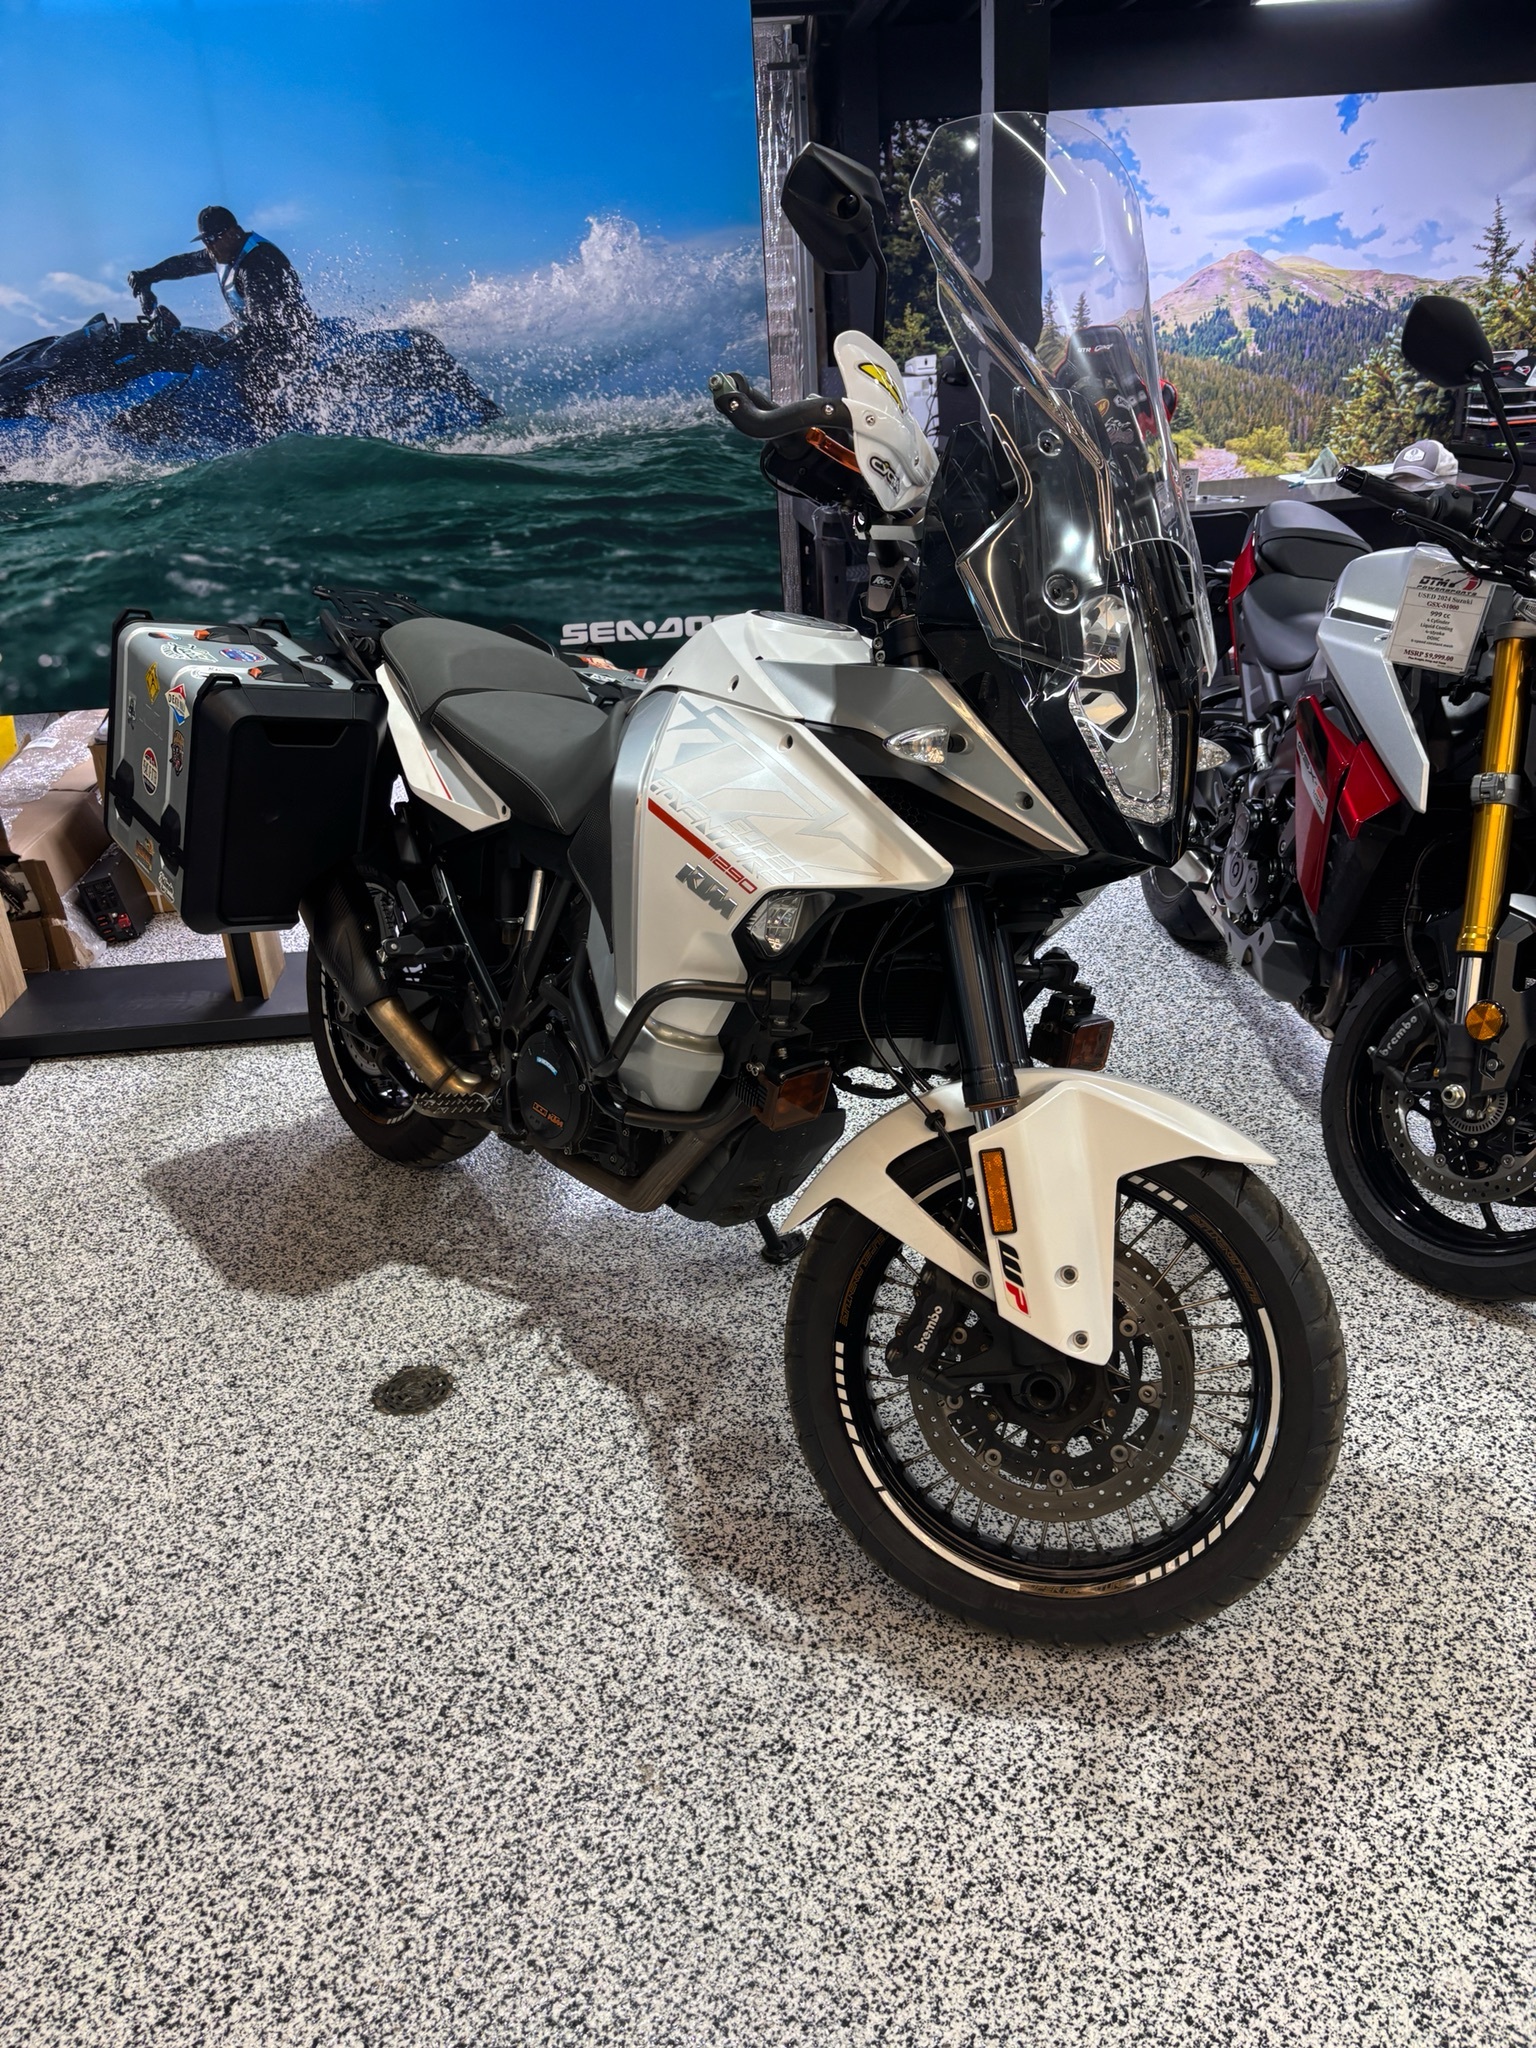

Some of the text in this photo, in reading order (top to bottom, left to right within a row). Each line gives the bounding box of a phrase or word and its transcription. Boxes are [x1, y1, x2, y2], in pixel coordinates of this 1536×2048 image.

[1419, 576, 1450, 587] DTM
[1418, 592, 1474, 605] USED 2024 Suzuki
[1430, 610, 1443, 618] 999
[1403, 649, 1424, 658] MSRP
[710, 853, 758, 895] 1290
[675, 862, 738, 920] KTM
[1379, 1015, 1418, 1057] brembo
[914, 1305, 943, 1353] brembo
